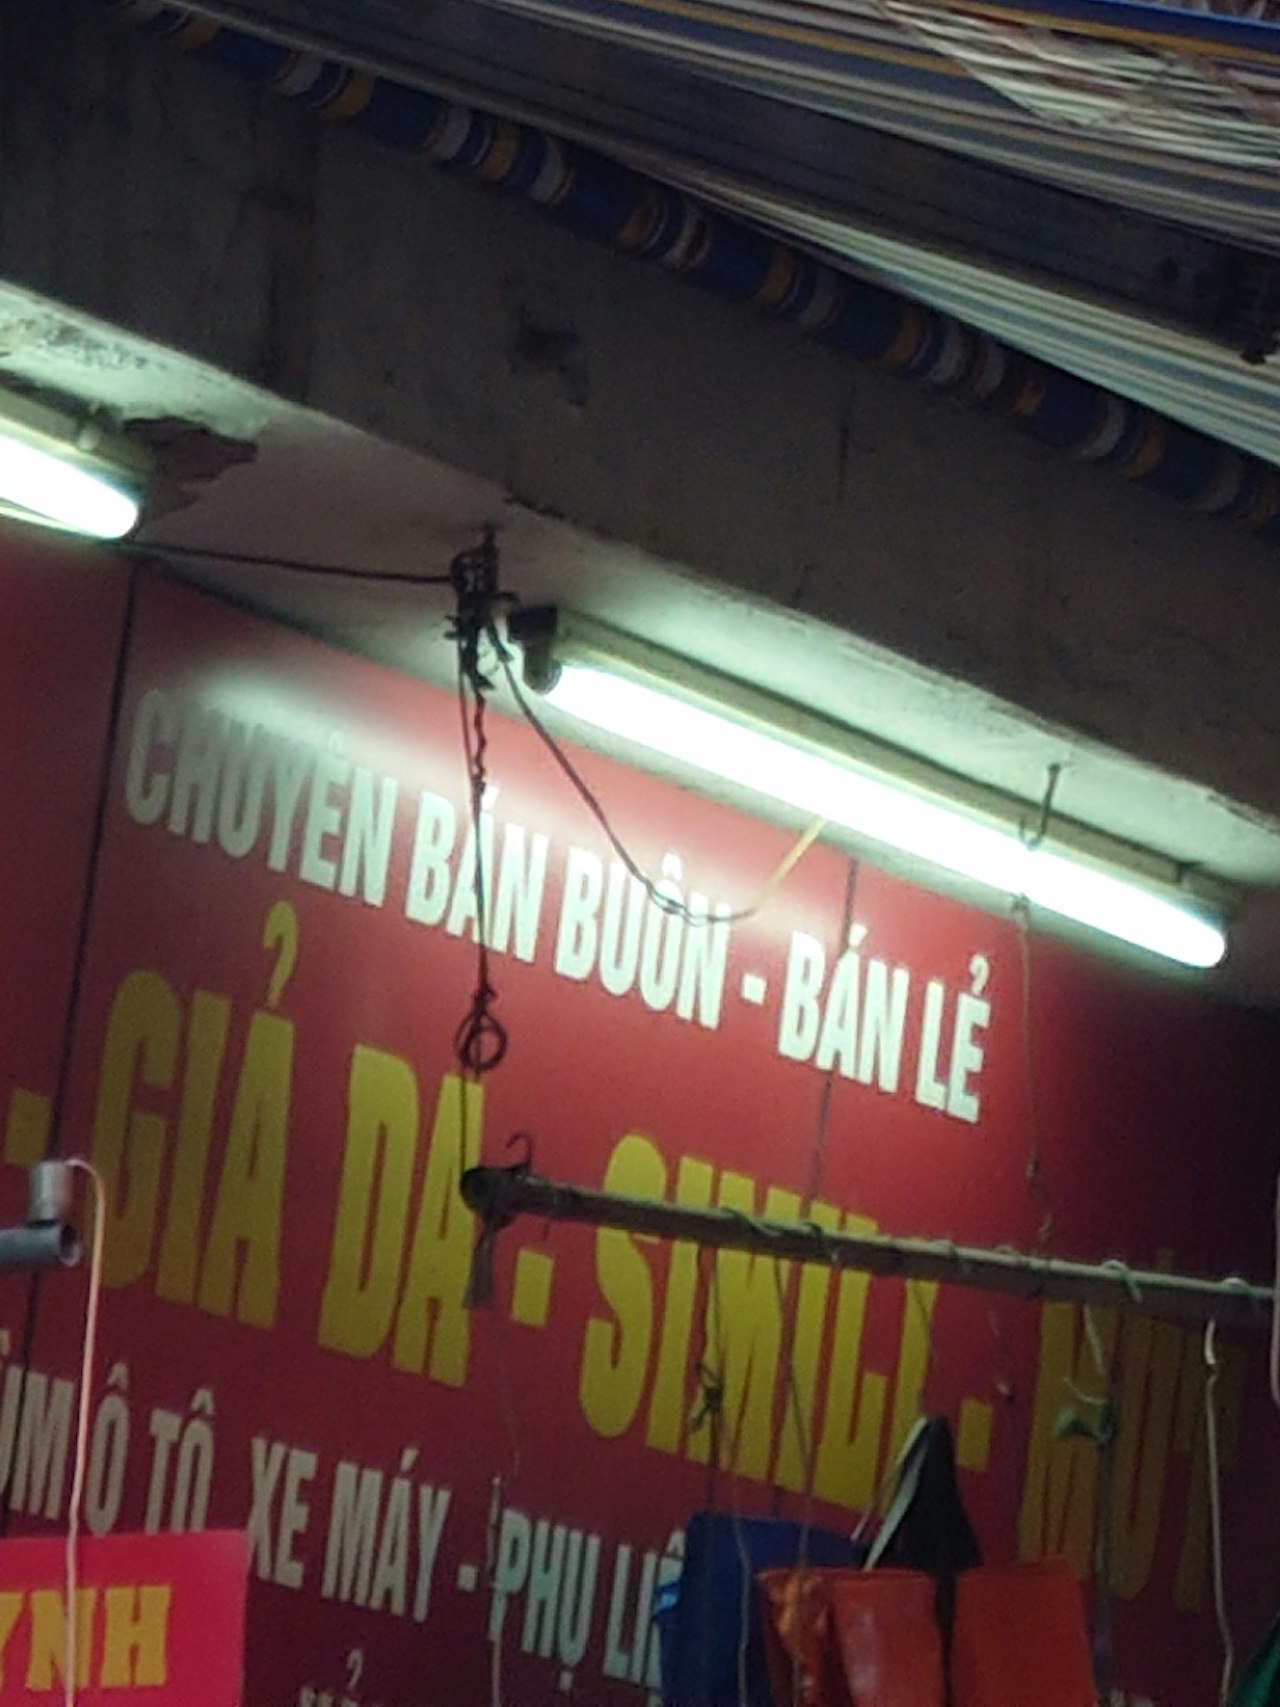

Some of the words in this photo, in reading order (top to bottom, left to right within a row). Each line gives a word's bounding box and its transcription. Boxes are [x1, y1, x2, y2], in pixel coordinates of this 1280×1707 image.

[126, 688, 397, 908] CHUYÊN
[405, 785, 548, 964] BÁN
[555, 846, 731, 1030] BUÔN
[778, 923, 909, 1095] BÁN
[915, 953, 991, 1124] LẺ
[87, 901, 298, 1330] GIẢ
[317, 1043, 485, 1388] DA
[86, 1361, 130, 1537] Ô
[144, 1386, 215, 1536] TÔ
[247, 1435, 317, 1590] XE
[320, 1447, 452, 1623] MÁY
[489, 1507, 602, 1692] PHỤ
